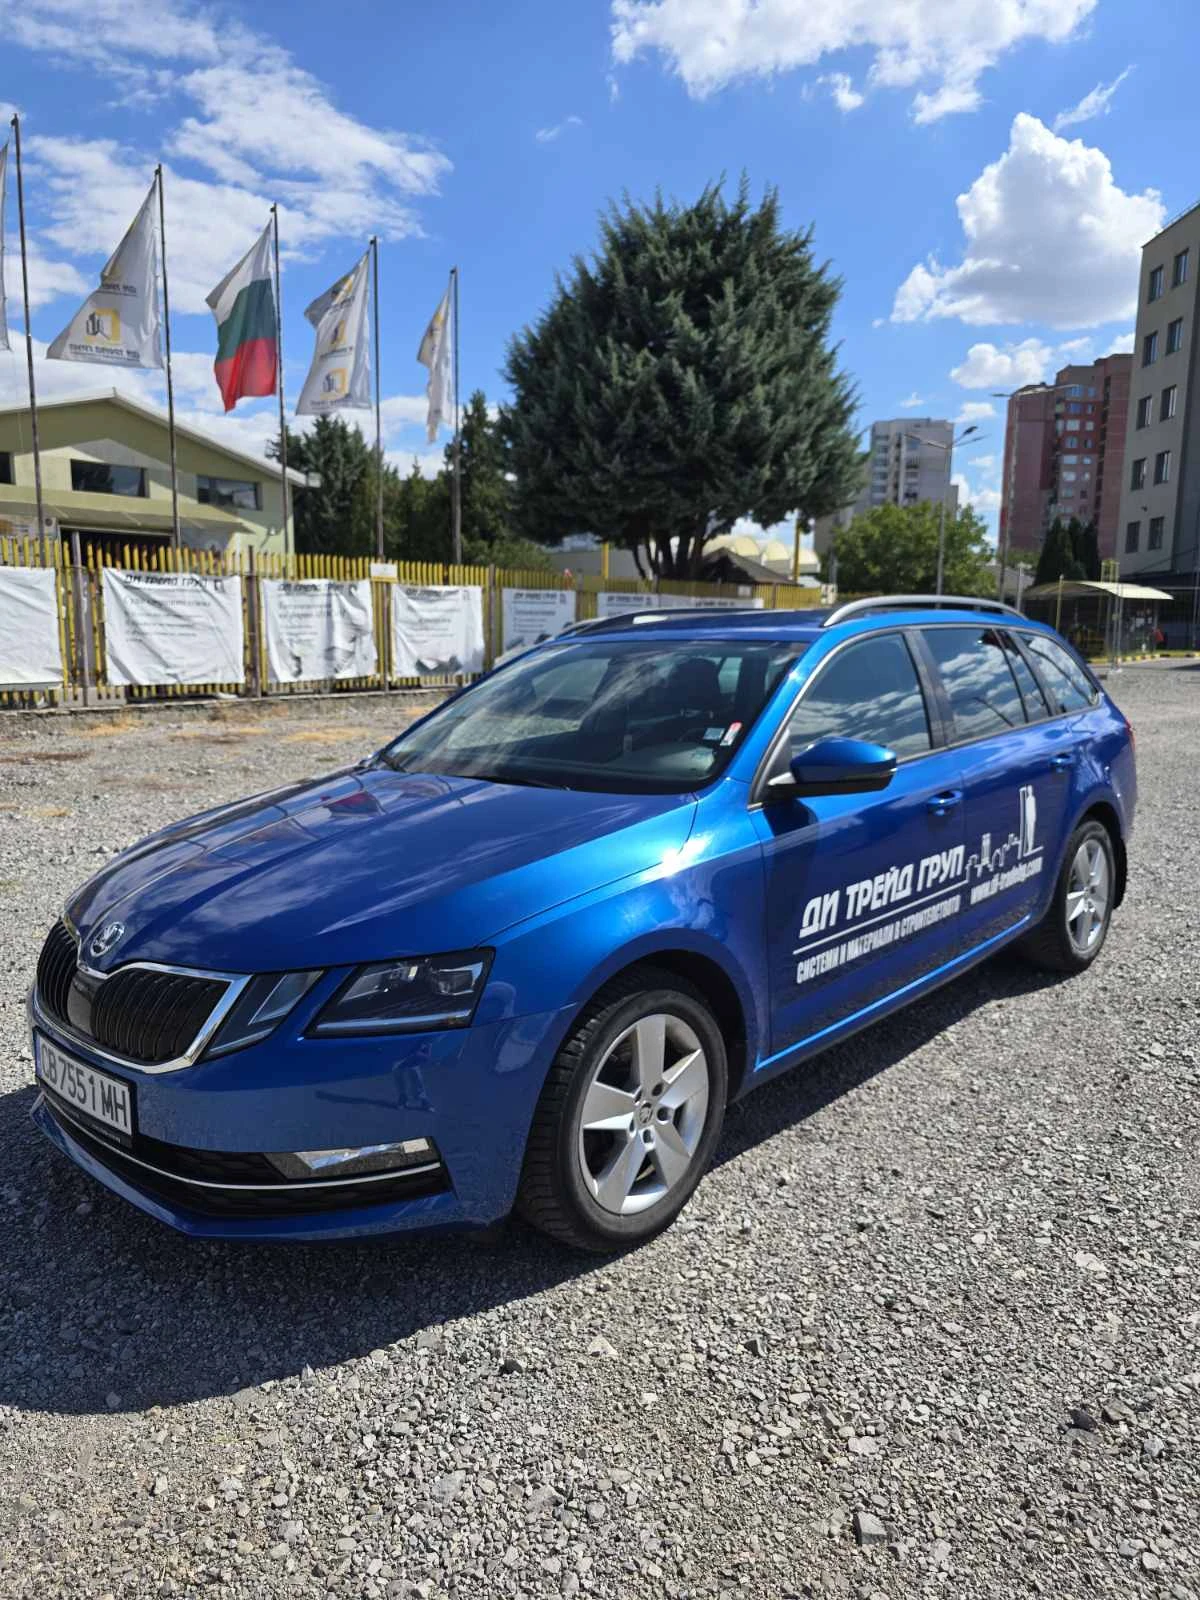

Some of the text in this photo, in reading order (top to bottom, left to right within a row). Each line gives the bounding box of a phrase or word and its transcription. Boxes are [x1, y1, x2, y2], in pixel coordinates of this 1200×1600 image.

[800, 845, 966, 938] ДИ ТРЕЙД ГРУП
[796, 947, 840, 984] СИСТЕМИ
[58, 1056, 96, 1112] 7551
[101, 1080, 127, 1127] MH
